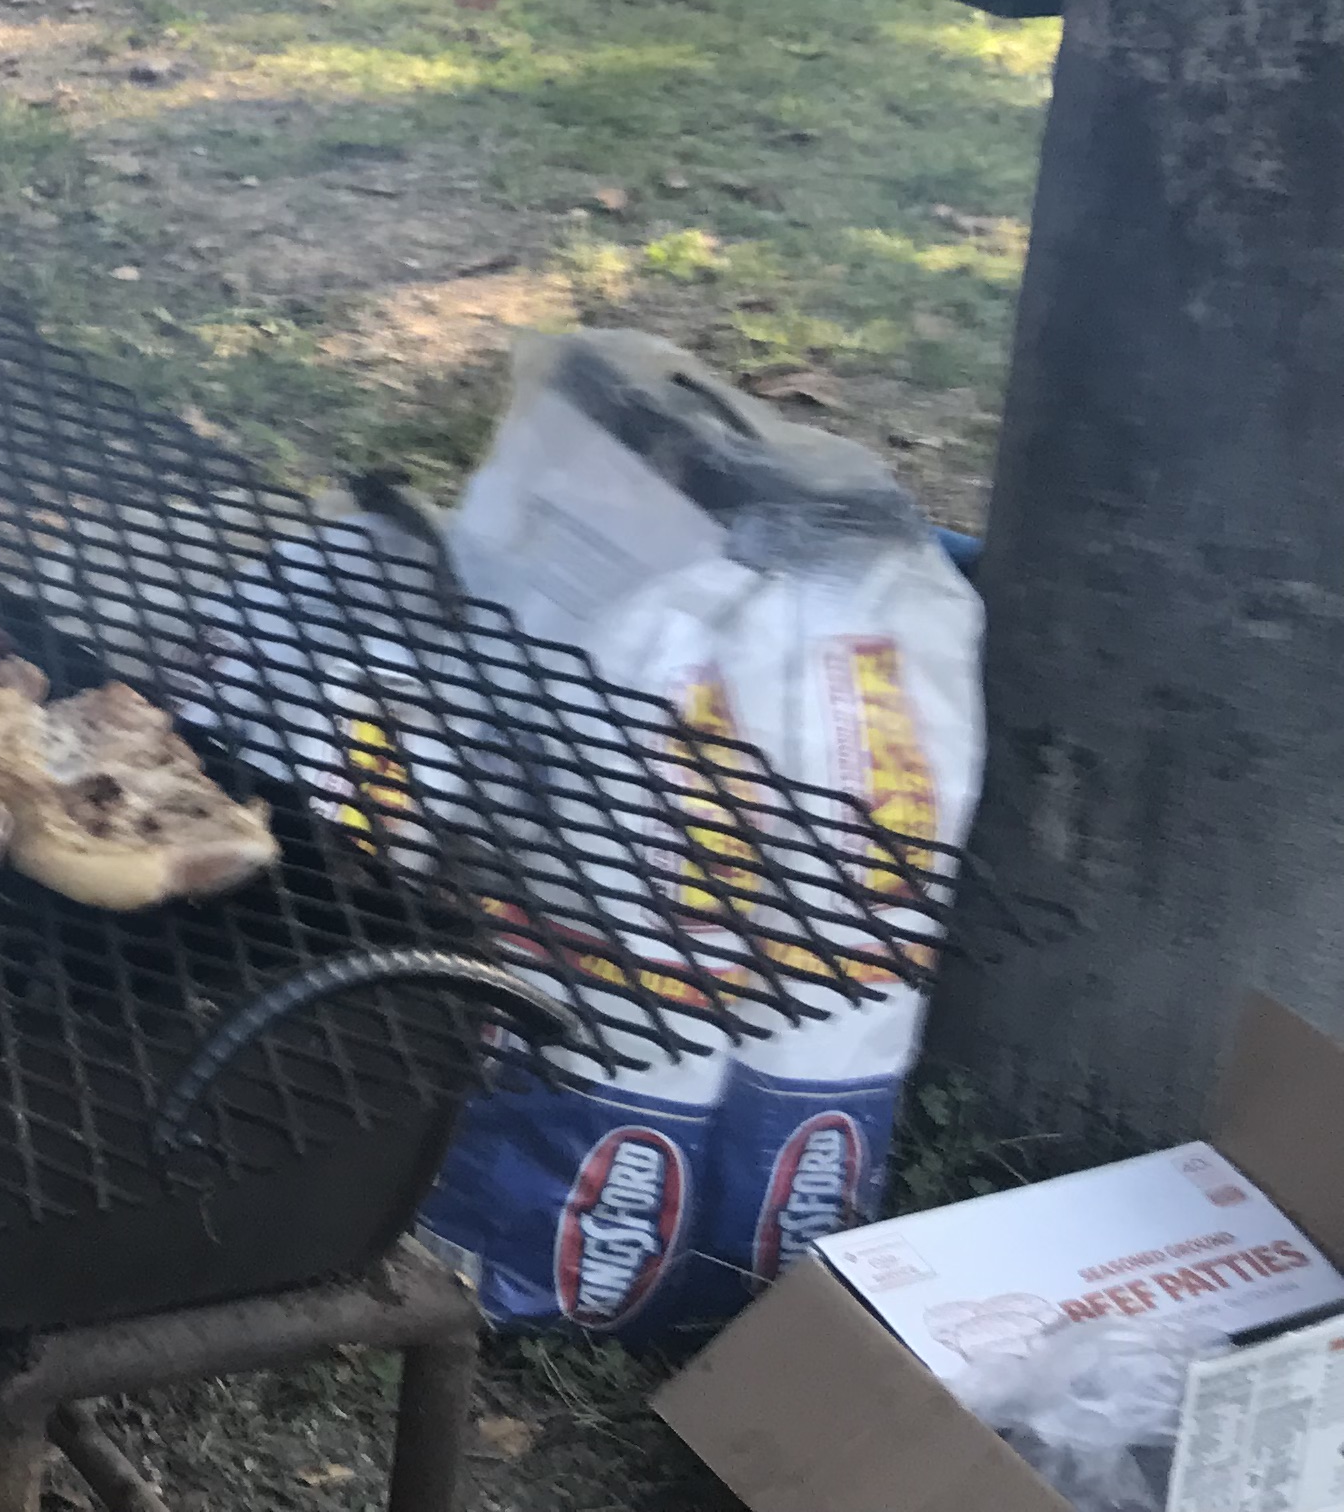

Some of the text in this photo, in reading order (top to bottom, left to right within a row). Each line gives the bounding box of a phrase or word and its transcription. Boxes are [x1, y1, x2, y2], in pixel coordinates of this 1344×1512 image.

[576, 1141, 660, 1317] KINGSFORD
[778, 1128, 842, 1274] SFORD
[1150, 1240, 1311, 1301] PATTIES
